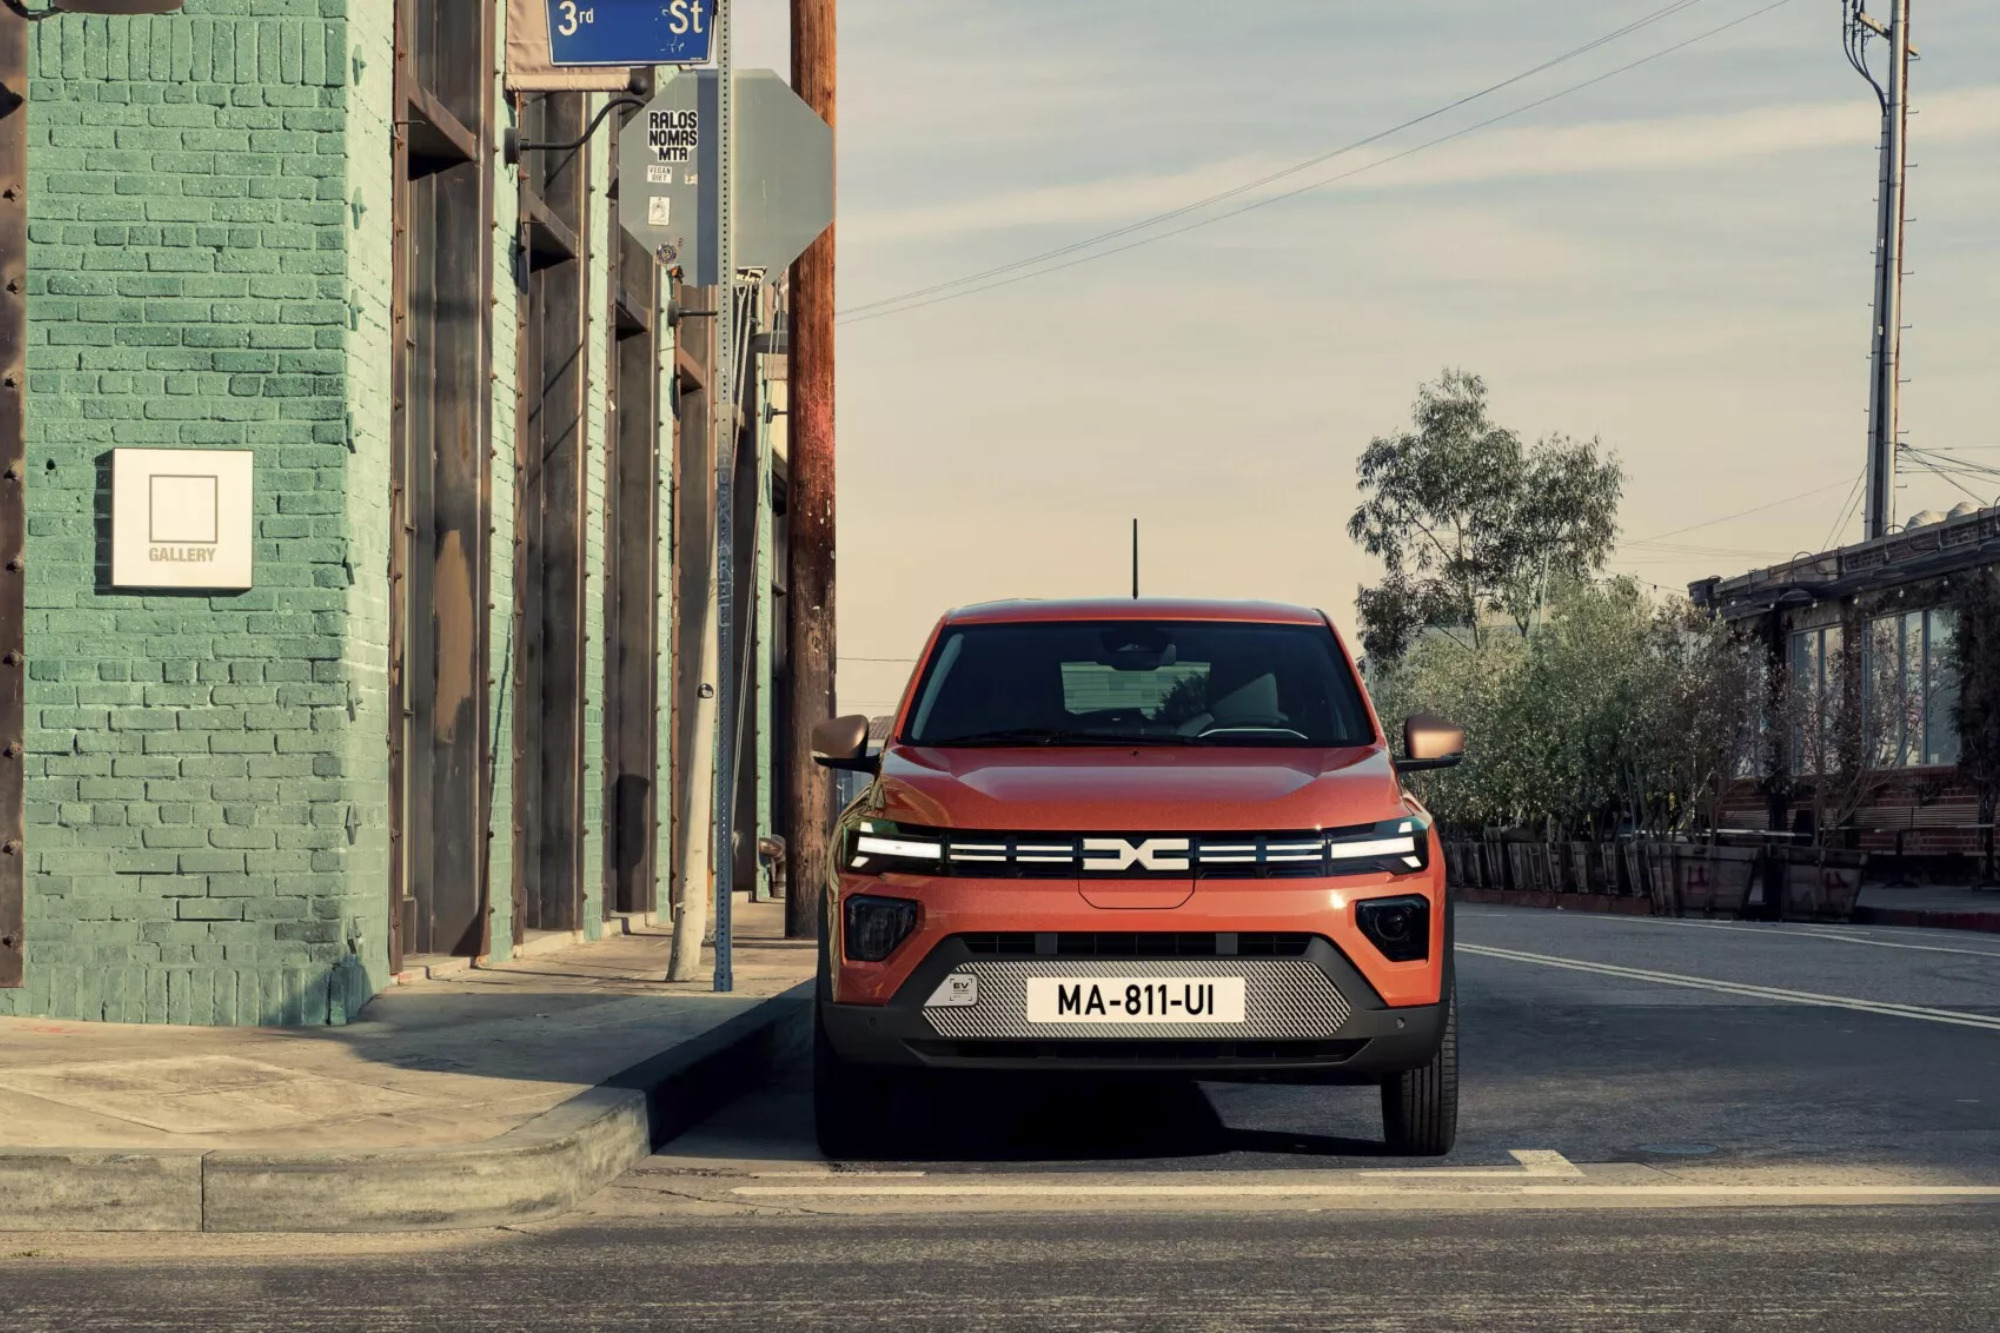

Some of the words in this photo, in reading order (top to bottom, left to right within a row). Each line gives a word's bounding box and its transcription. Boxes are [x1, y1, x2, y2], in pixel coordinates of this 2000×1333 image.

[558, 0, 594, 36] 3rd
[669, 0, 703, 34] St
[649, 111, 698, 129] RALOS
[649, 130, 698, 146] NOMAS
[658, 147, 688, 161] MTA
[148, 547, 216, 563] GALLERY
[1057, 983, 1214, 1015] MA-811-UI
